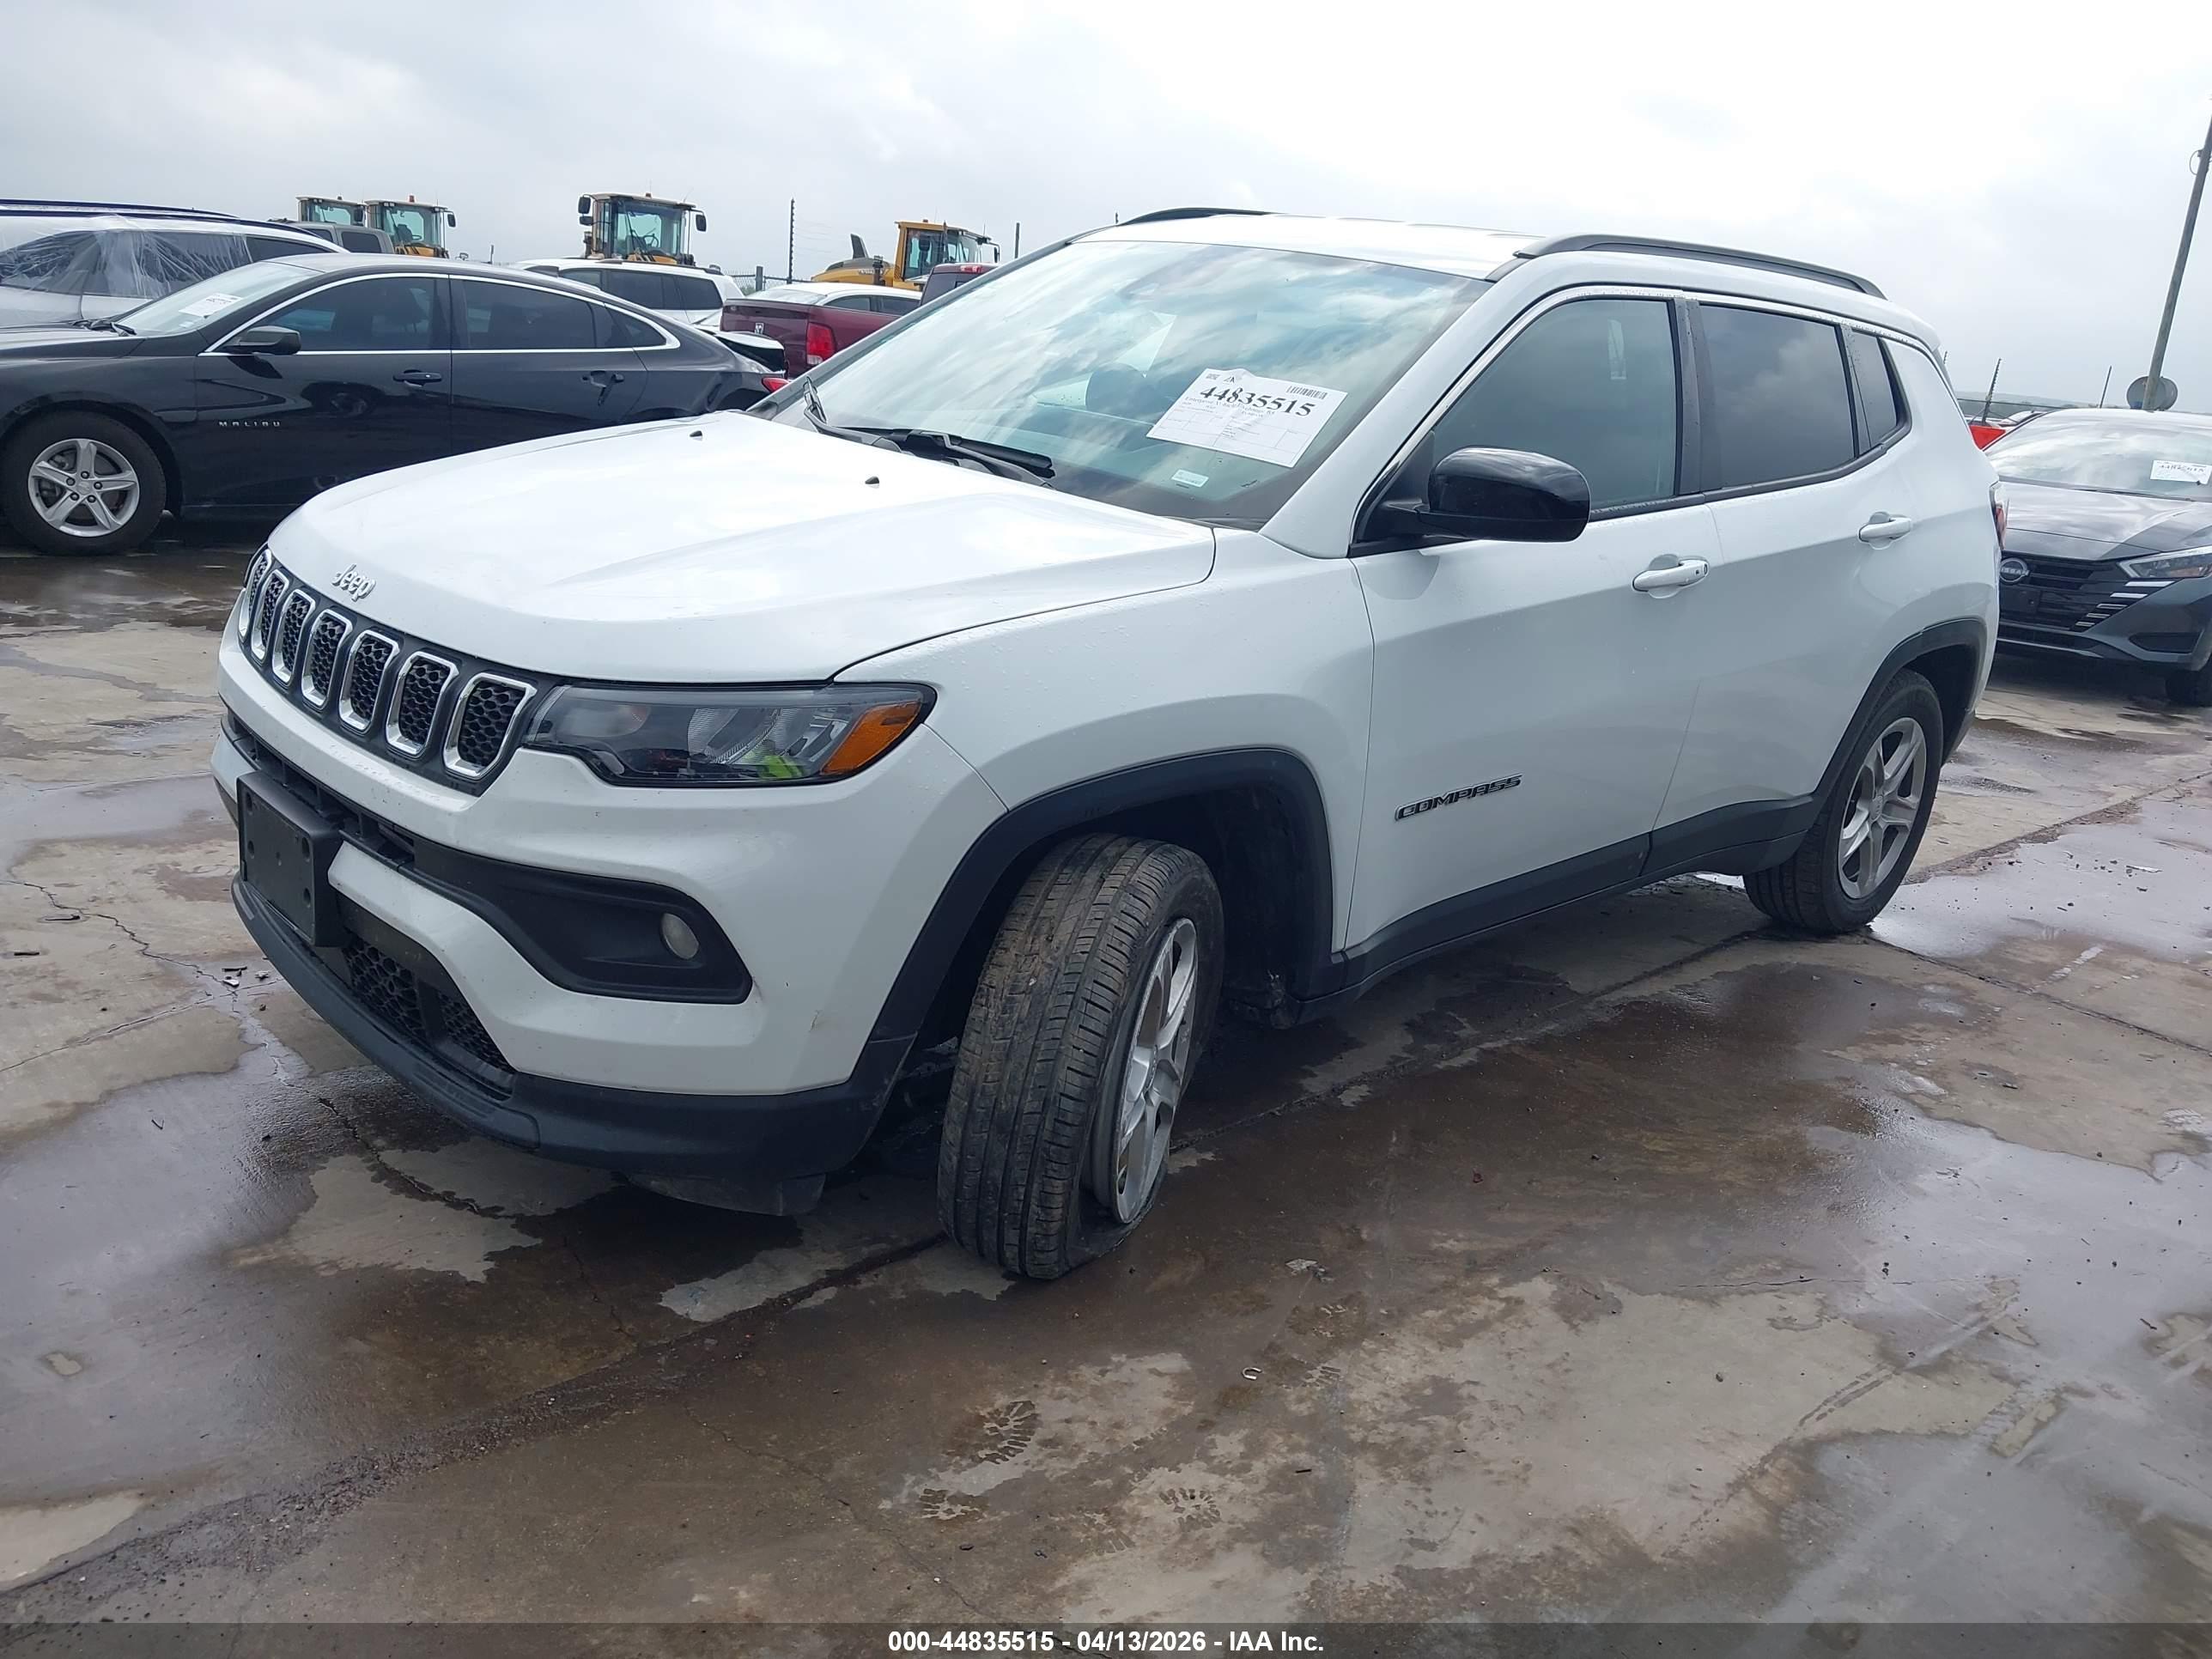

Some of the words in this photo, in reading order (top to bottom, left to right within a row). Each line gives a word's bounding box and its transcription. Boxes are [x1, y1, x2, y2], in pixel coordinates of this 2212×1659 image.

[1200, 386, 1316, 416] 44835515
[331, 563, 376, 602] Jeep
[2000, 566, 2030, 576] ISSAN
[1395, 773, 1522, 821] COMPASS
